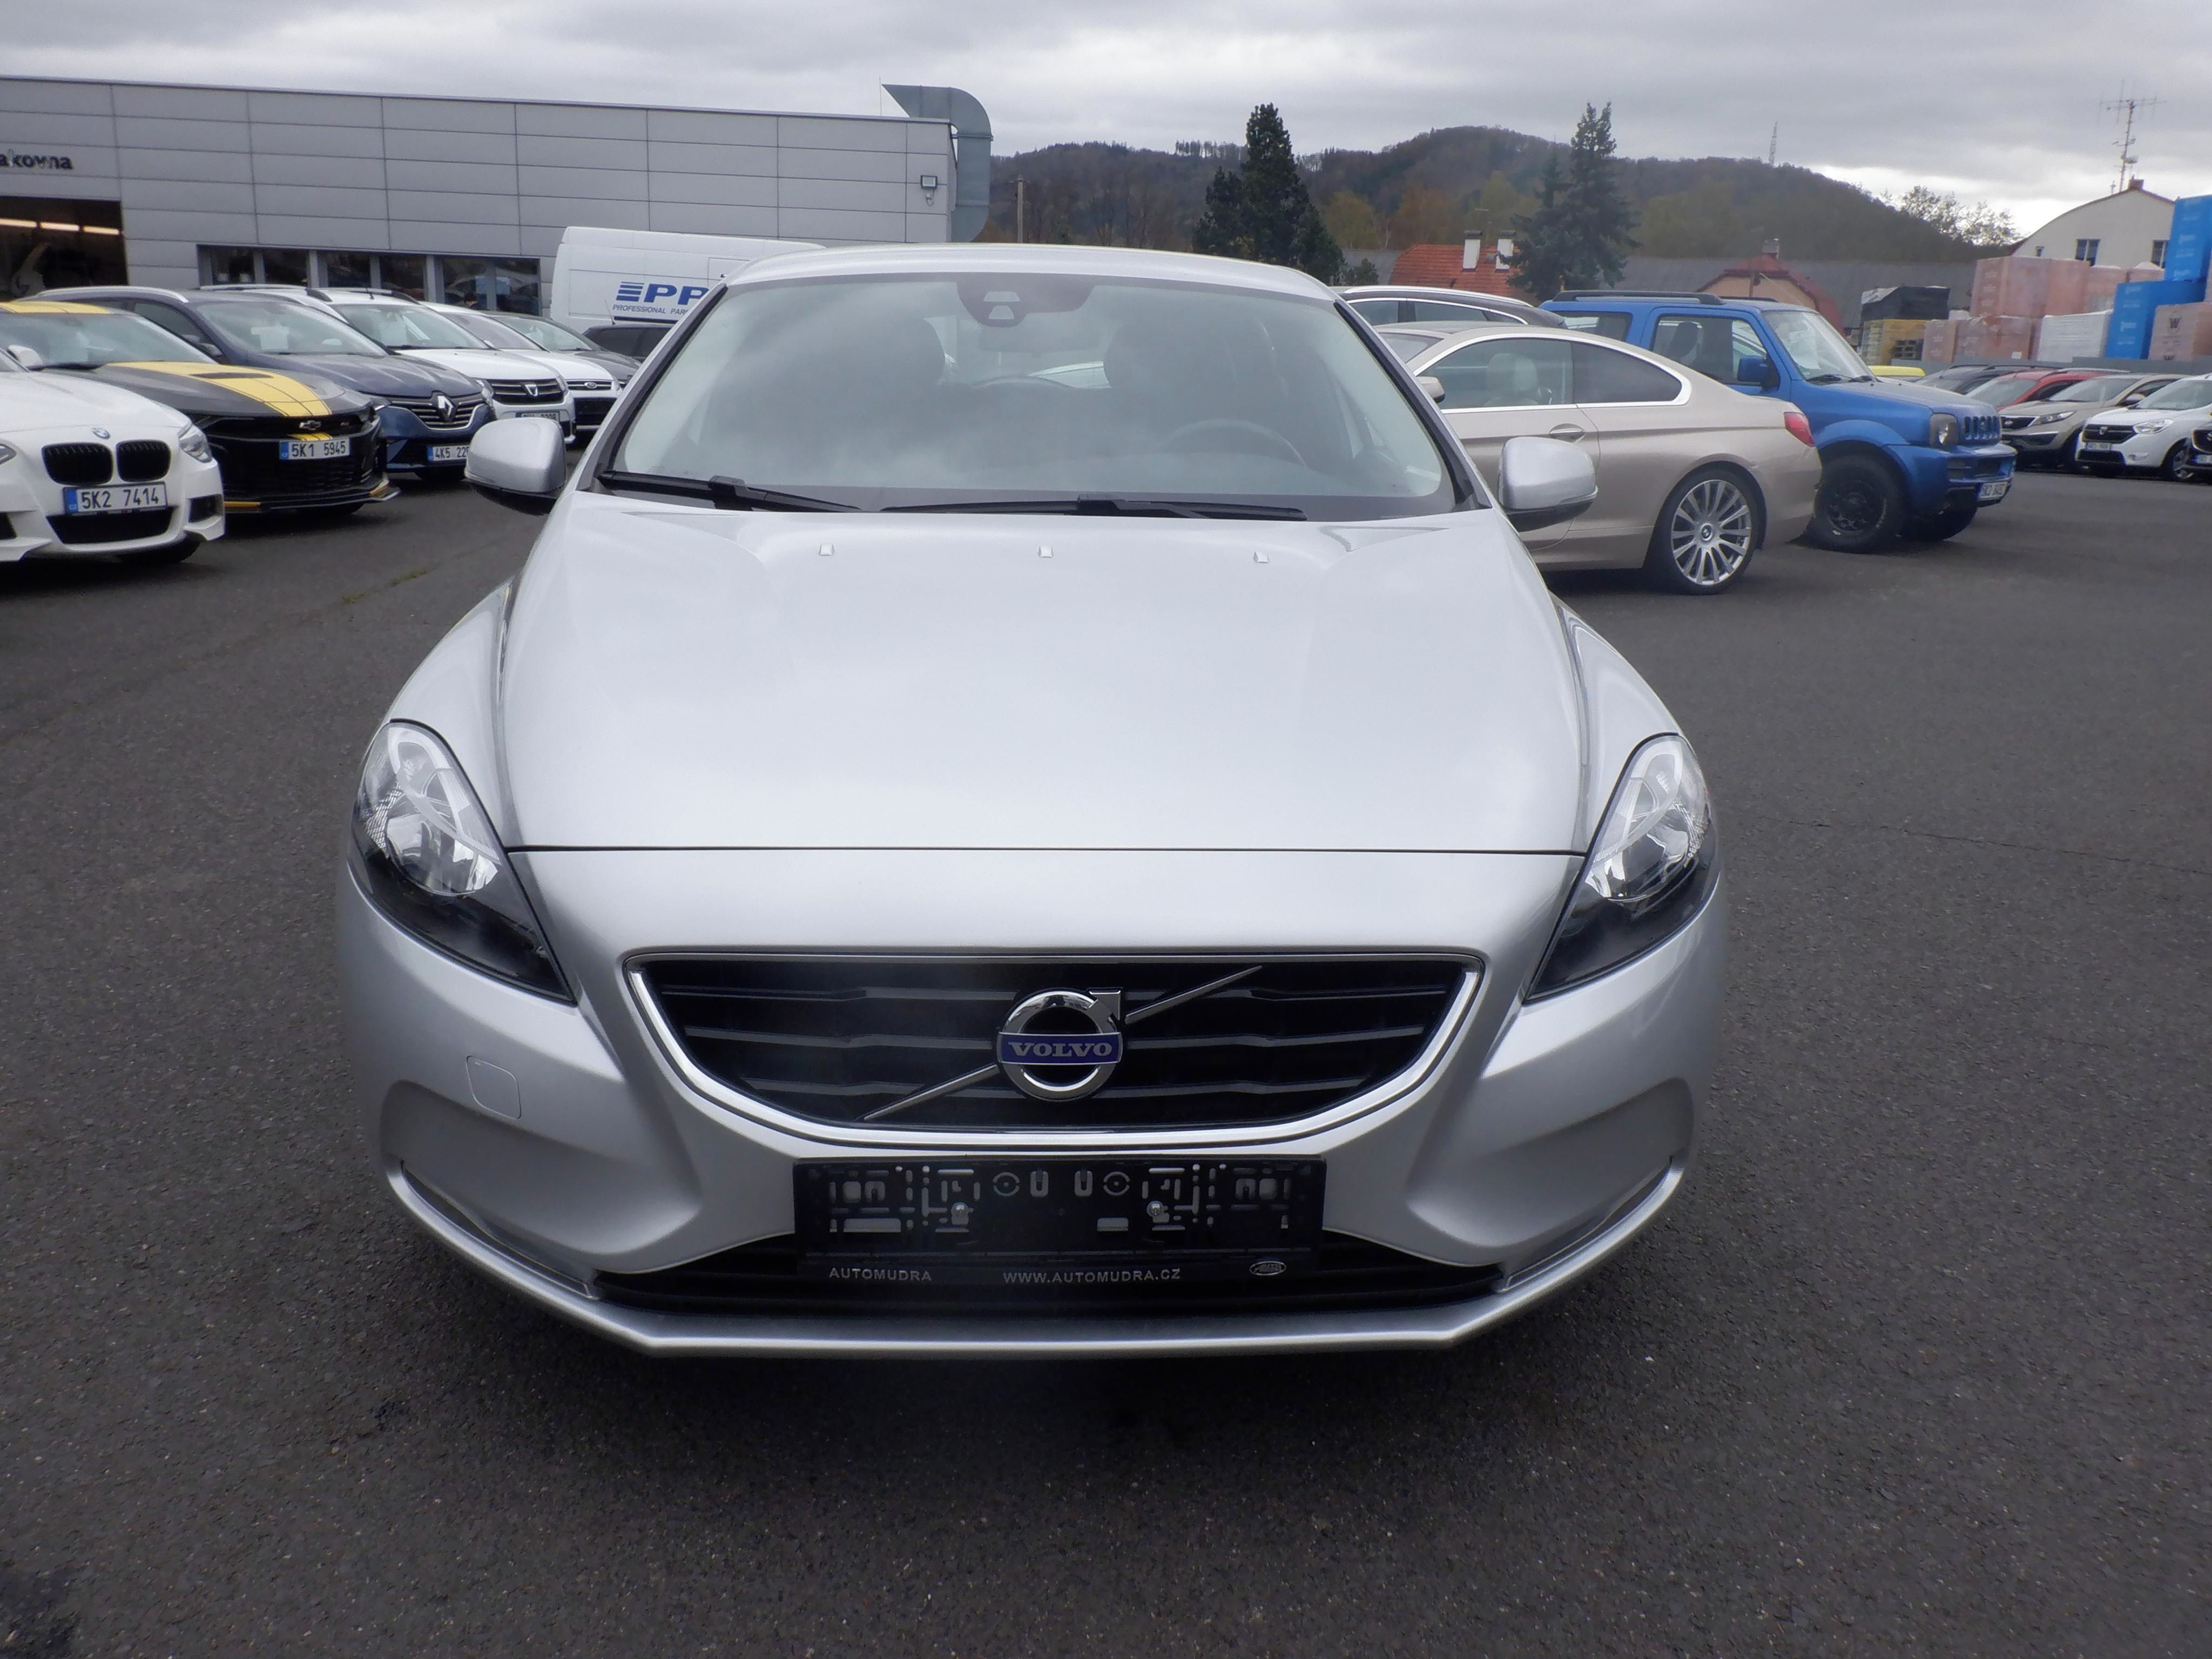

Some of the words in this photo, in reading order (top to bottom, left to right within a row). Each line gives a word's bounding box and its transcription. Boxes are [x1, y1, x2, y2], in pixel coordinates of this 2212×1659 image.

[612, 304, 666, 314] PROFESSIONAL
[292, 443, 314, 457] 5K1
[323, 441, 346, 455] 5945
[435, 447, 450, 458] 4K5
[81, 490, 111, 509] 5K2
[123, 487, 158, 507] 7414
[1008, 1042, 1112, 1057] VOLVO
[829, 1267, 932, 1281] AUTOMUDRA
[1003, 1267, 1181, 1283] WWW.AUTOMUDRA.CZ
